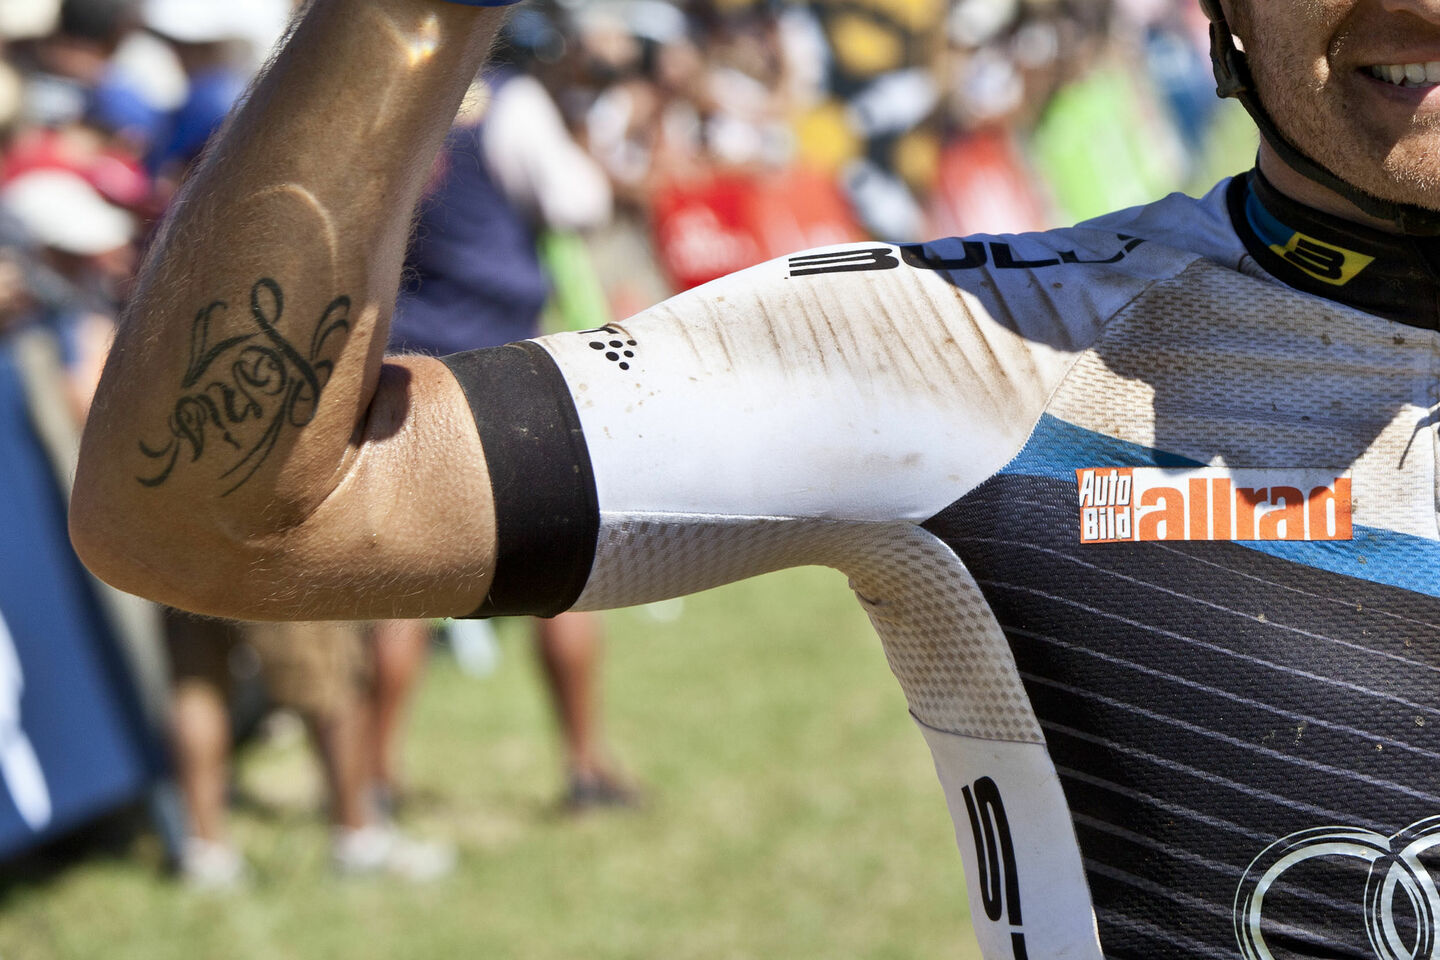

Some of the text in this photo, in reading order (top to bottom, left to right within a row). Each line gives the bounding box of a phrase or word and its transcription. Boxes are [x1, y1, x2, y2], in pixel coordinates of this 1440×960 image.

[1079, 470, 1132, 507] Auto
[1083, 507, 1132, 540] Bild
[1139, 477, 1352, 540] allrad
